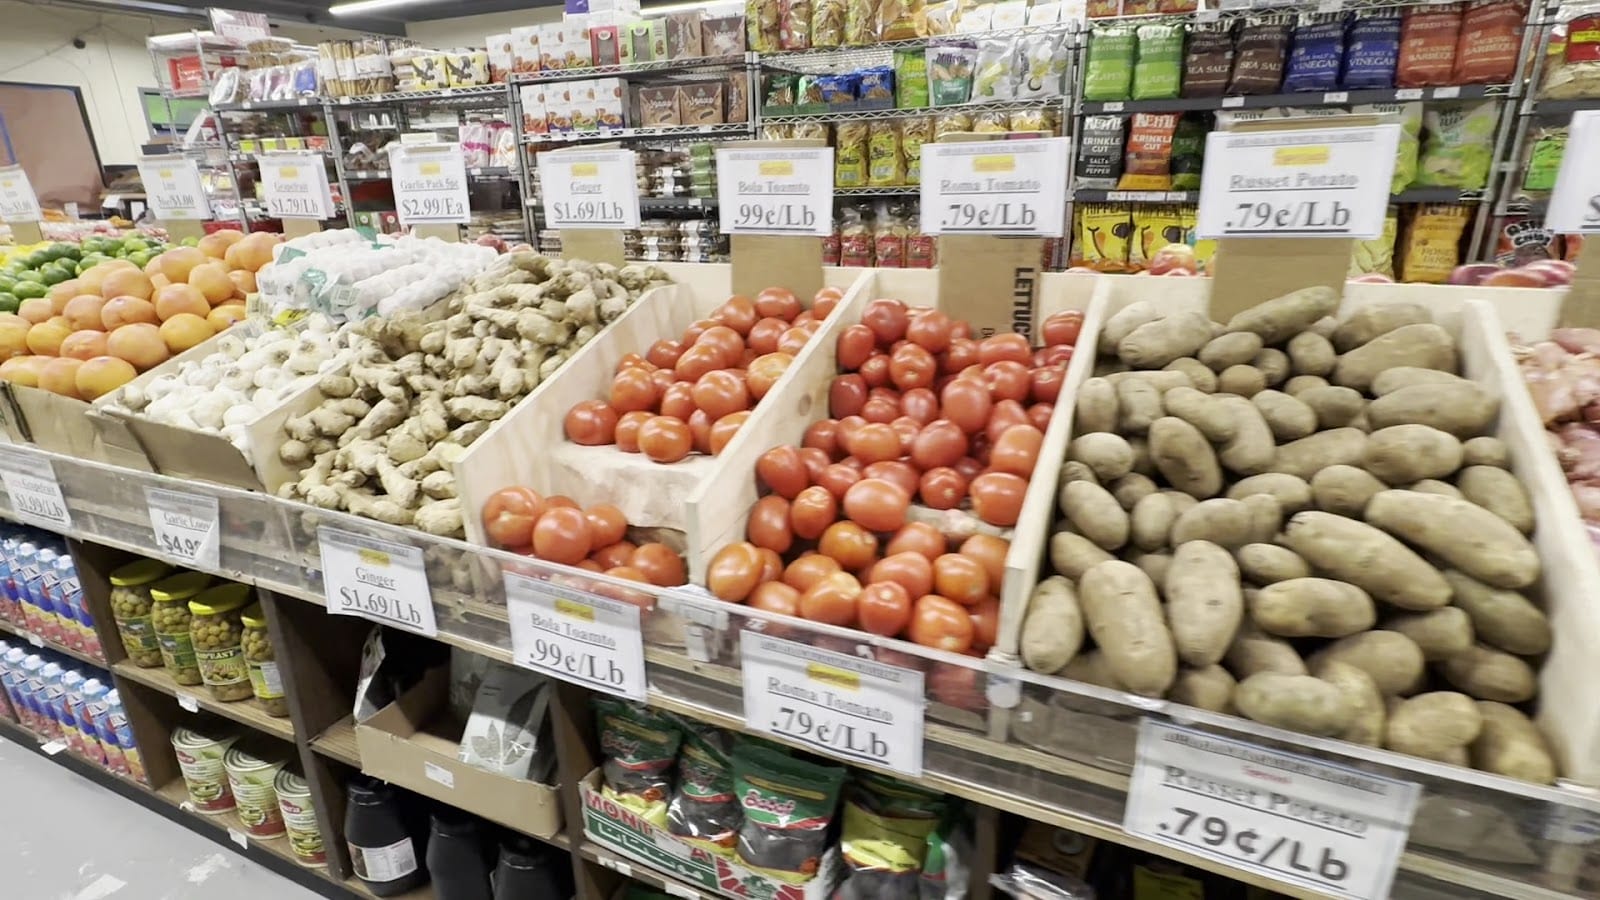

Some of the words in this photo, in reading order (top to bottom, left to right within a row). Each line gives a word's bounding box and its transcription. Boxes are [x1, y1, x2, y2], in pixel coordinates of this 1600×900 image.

[1206, 64, 1230, 73] SALT
[570, 181, 602, 194] Ginger
[940, 180, 980, 192] Roma
[986, 178, 1041, 191] Tomato
[1230, 174, 1289, 188] Russet
[1296, 172, 1359, 187] Potato
[272, 198, 319, 214] $1.79/Lb
[402, 197, 464, 216] $2.99/Ea
[554, 201, 624, 221] $1.69/Lb
[734, 204, 815, 226] .99¢/Lb
[942, 203, 1036, 226] .79¢/Lb
[1225, 201, 1352, 228] .79¢/Lb
[355, 566, 396, 588] Ginger
[340, 586, 421, 624] $1.69/Lb
[531, 612, 561, 632] Bola
[530, 638, 624, 685] .99¢/Lb
[768, 676, 820, 701] Roma
[823, 690, 894, 721] Tomato
[771, 706, 889, 758] .79¢/Lb
[1164, 765, 1258, 802] Russet
[1267, 792, 1369, 833] Potato
[1158, 806, 1349, 882] .79¢/Lb
